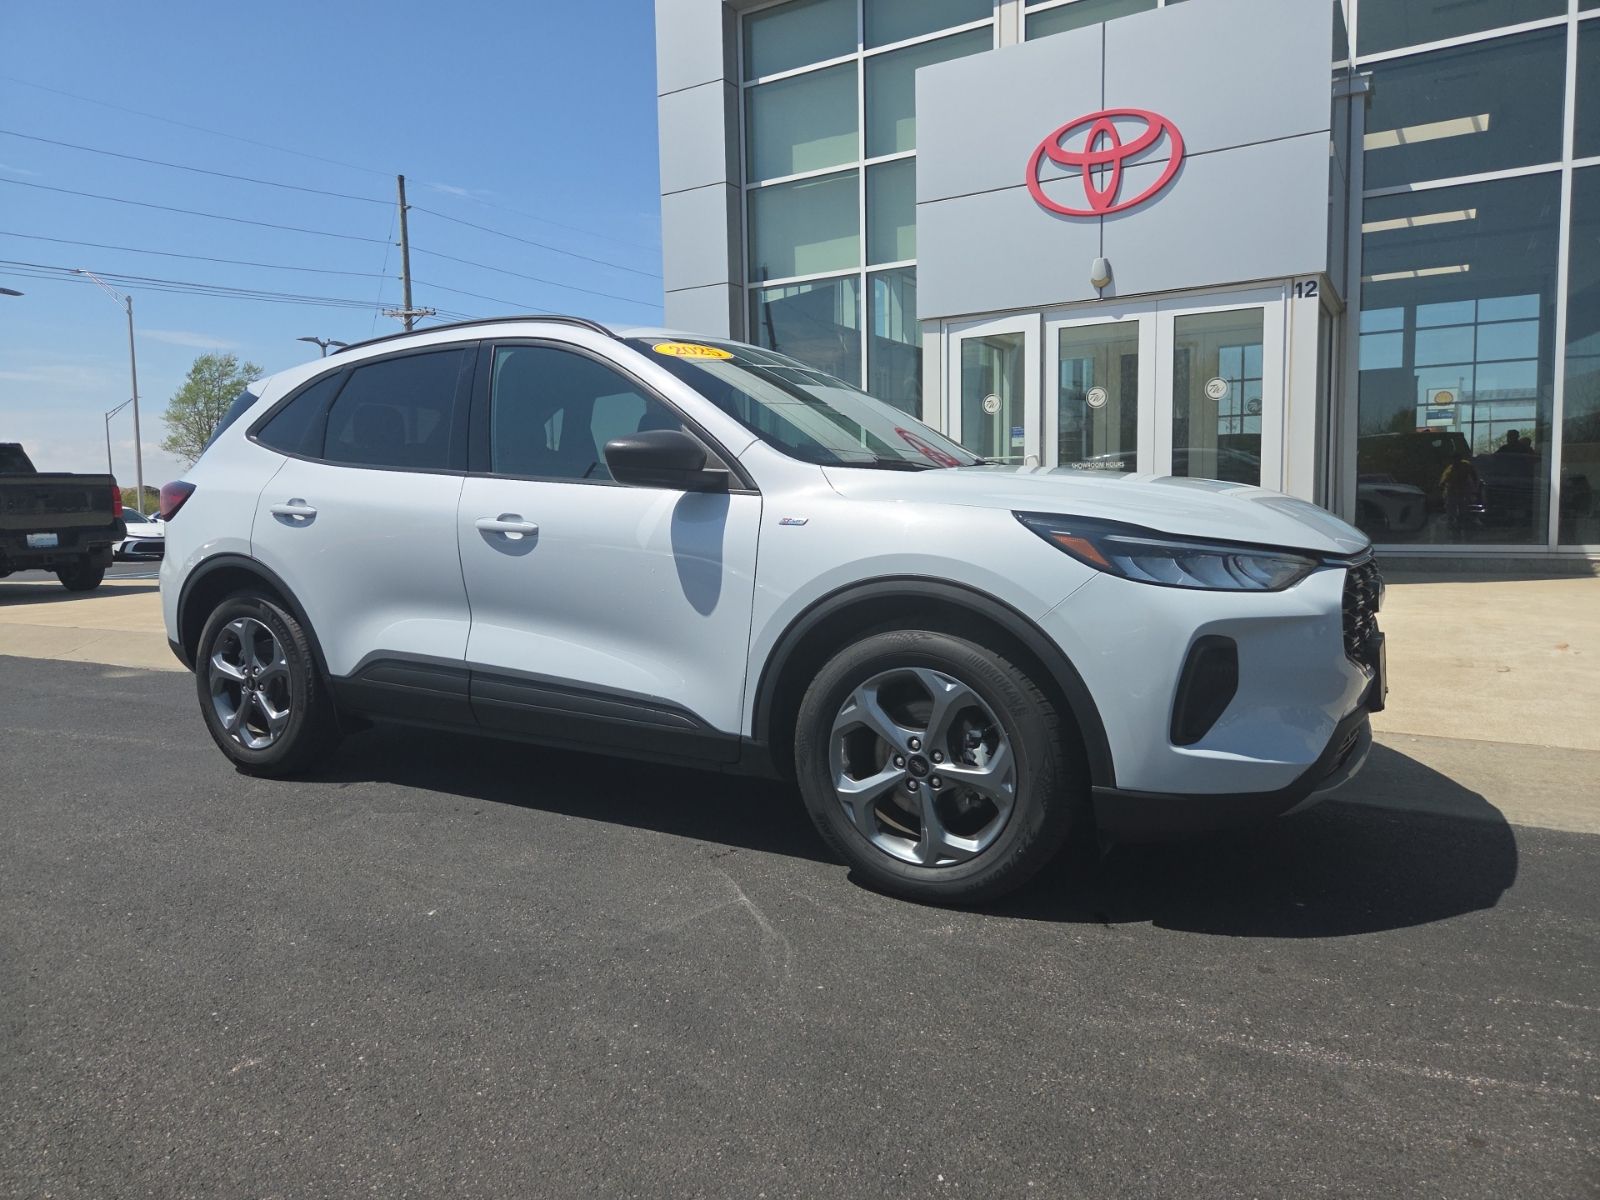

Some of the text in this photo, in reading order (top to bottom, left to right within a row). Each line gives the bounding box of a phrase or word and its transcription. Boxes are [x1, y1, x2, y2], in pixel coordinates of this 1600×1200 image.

[1295, 280, 1318, 299] 12
[669, 345, 723, 358] 2025
[1105, 461, 1125, 469] HOURS
